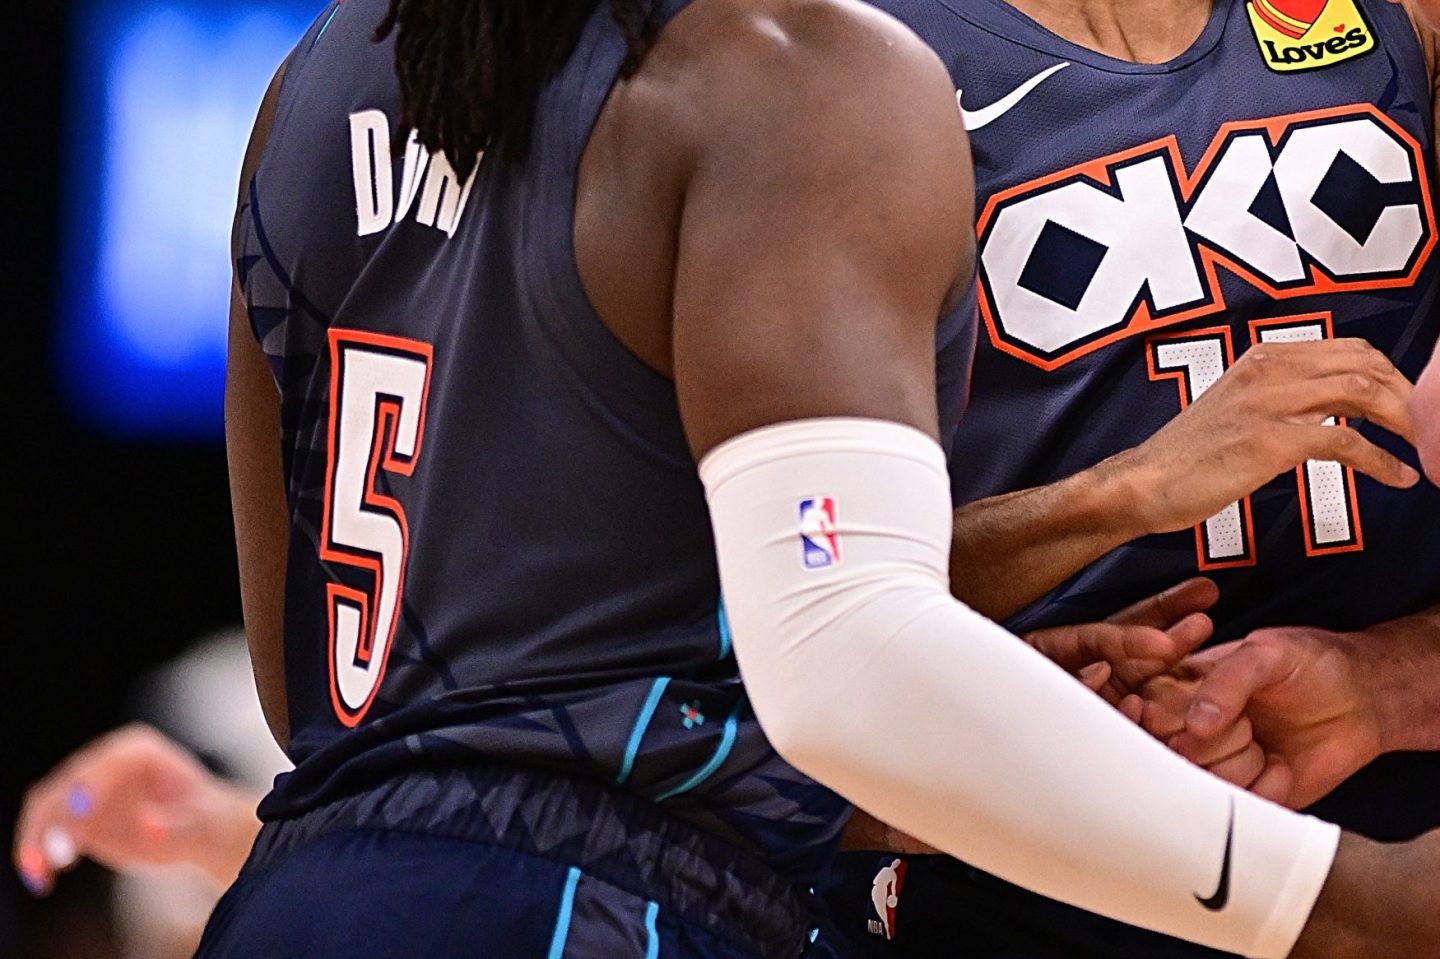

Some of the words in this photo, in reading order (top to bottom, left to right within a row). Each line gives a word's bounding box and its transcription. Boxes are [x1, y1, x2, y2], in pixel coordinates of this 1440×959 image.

[977, 104, 1438, 371] OKC
[319, 327, 434, 728] 5
[1145, 312, 1364, 569] 11
[867, 919, 883, 935] NBA
